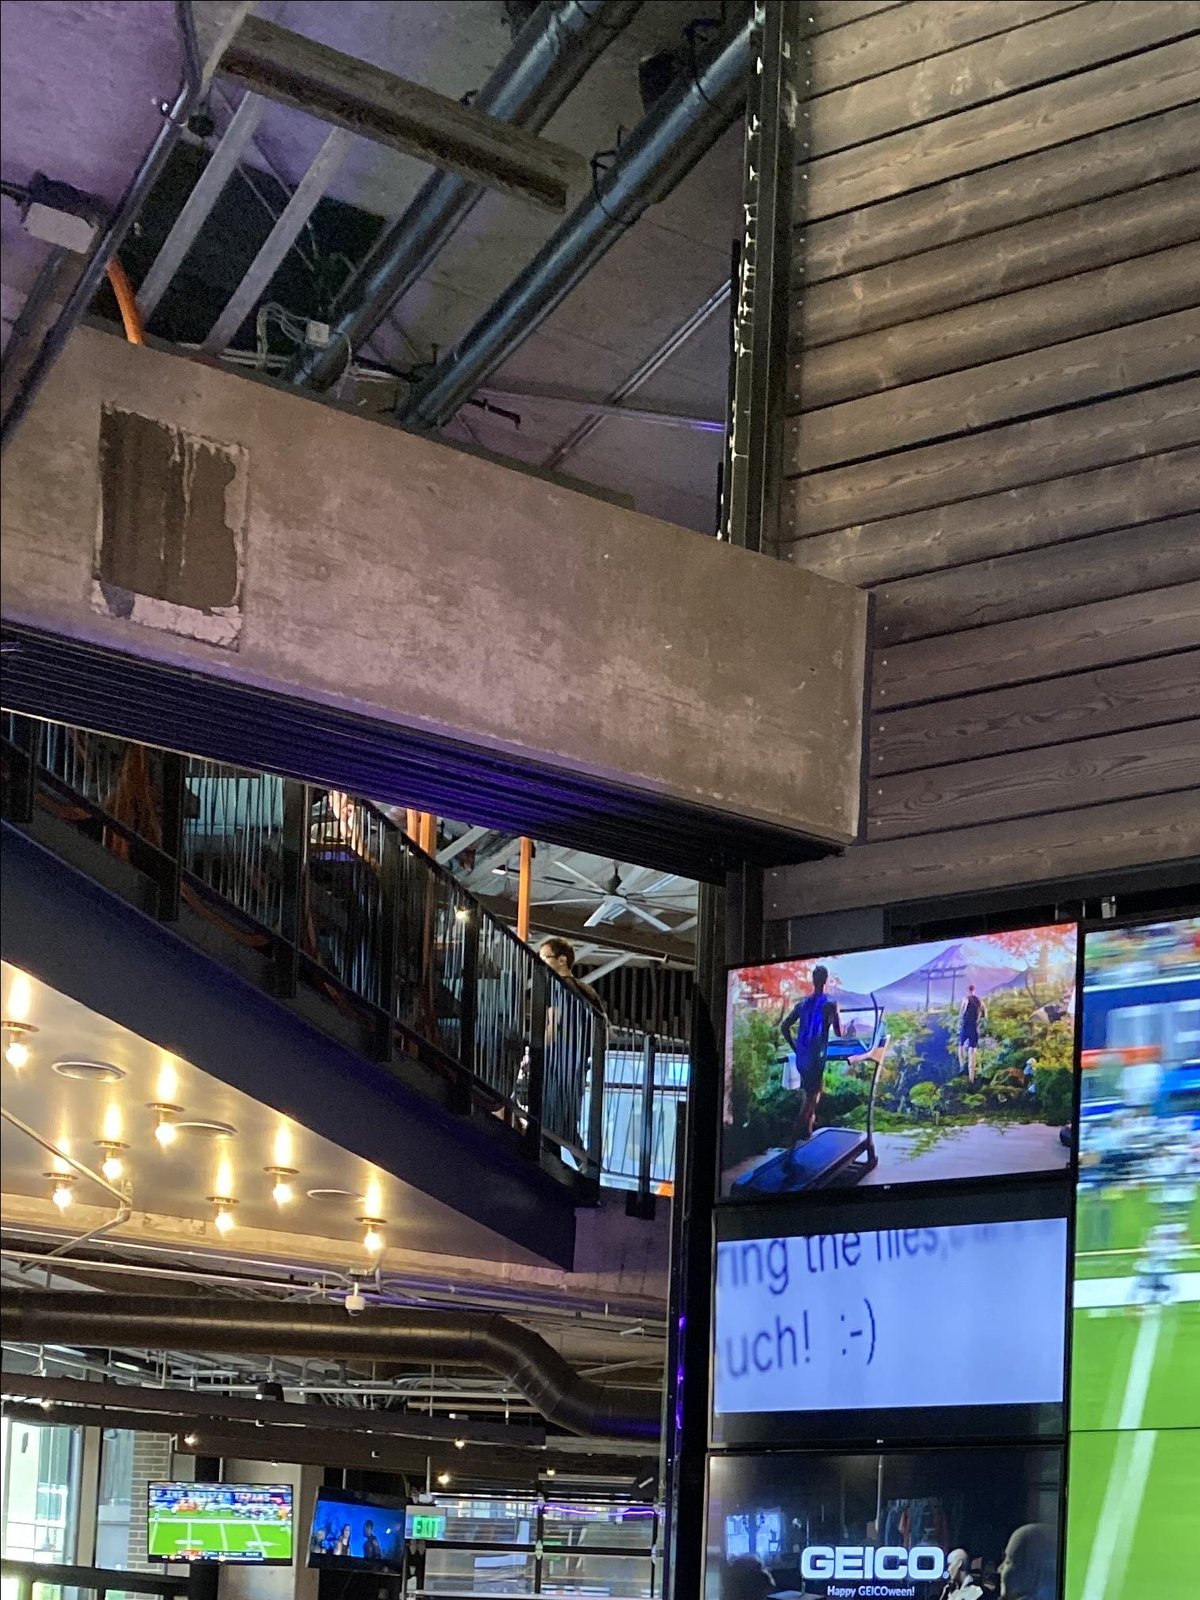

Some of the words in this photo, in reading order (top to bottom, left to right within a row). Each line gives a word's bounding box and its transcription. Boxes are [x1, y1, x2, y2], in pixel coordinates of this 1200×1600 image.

[413, 1516, 441, 1538] EXIT
[801, 1546, 945, 1580] GEICO
[827, 1585, 856, 1598] Happy
[858, 1585, 915, 1597] GEICOween!
